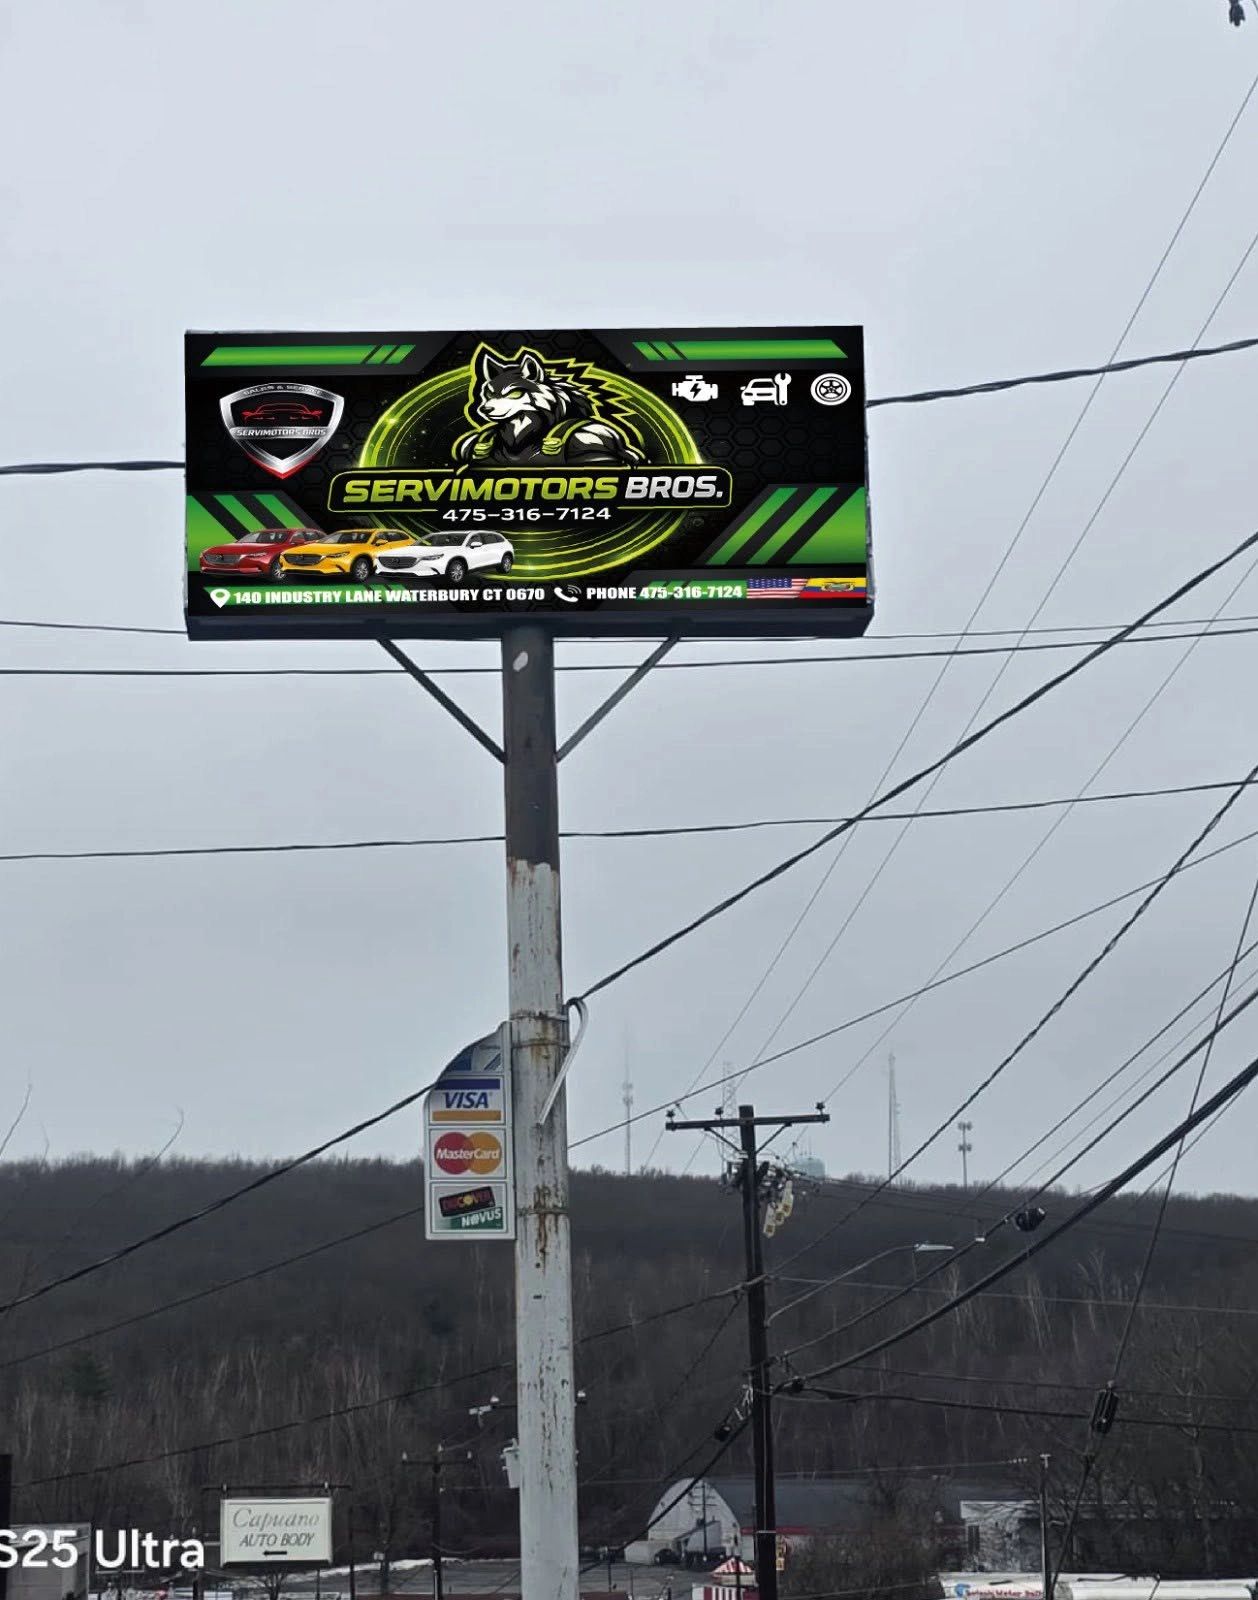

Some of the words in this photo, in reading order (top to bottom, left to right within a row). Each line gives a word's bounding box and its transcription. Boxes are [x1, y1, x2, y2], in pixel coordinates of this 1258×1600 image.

[343, 476, 619, 503] SERVIMOTORS
[625, 475, 723, 499] BROS.
[442, 506, 612, 522] 475-316-7124
[233, 591, 262, 604] 140
[265, 590, 344, 604] INDUSTRY
[345, 590, 383, 603] LANE
[384, 589, 479, 602] WATERBURY
[482, 588, 504, 601] CT
[505, 587, 546, 601] 0670
[586, 586, 637, 599] PHONE
[639, 585, 744, 599] 475-316-7124
[443, 1092, 490, 1109] VISA
[436, 1148, 500, 1160] MasterCard
[461, 1208, 502, 1228] NOVUS
[232, 1507, 320, 1532] Capuano
[239, 1533, 278, 1547] AUTO
[280, 1532, 315, 1547] BODY
